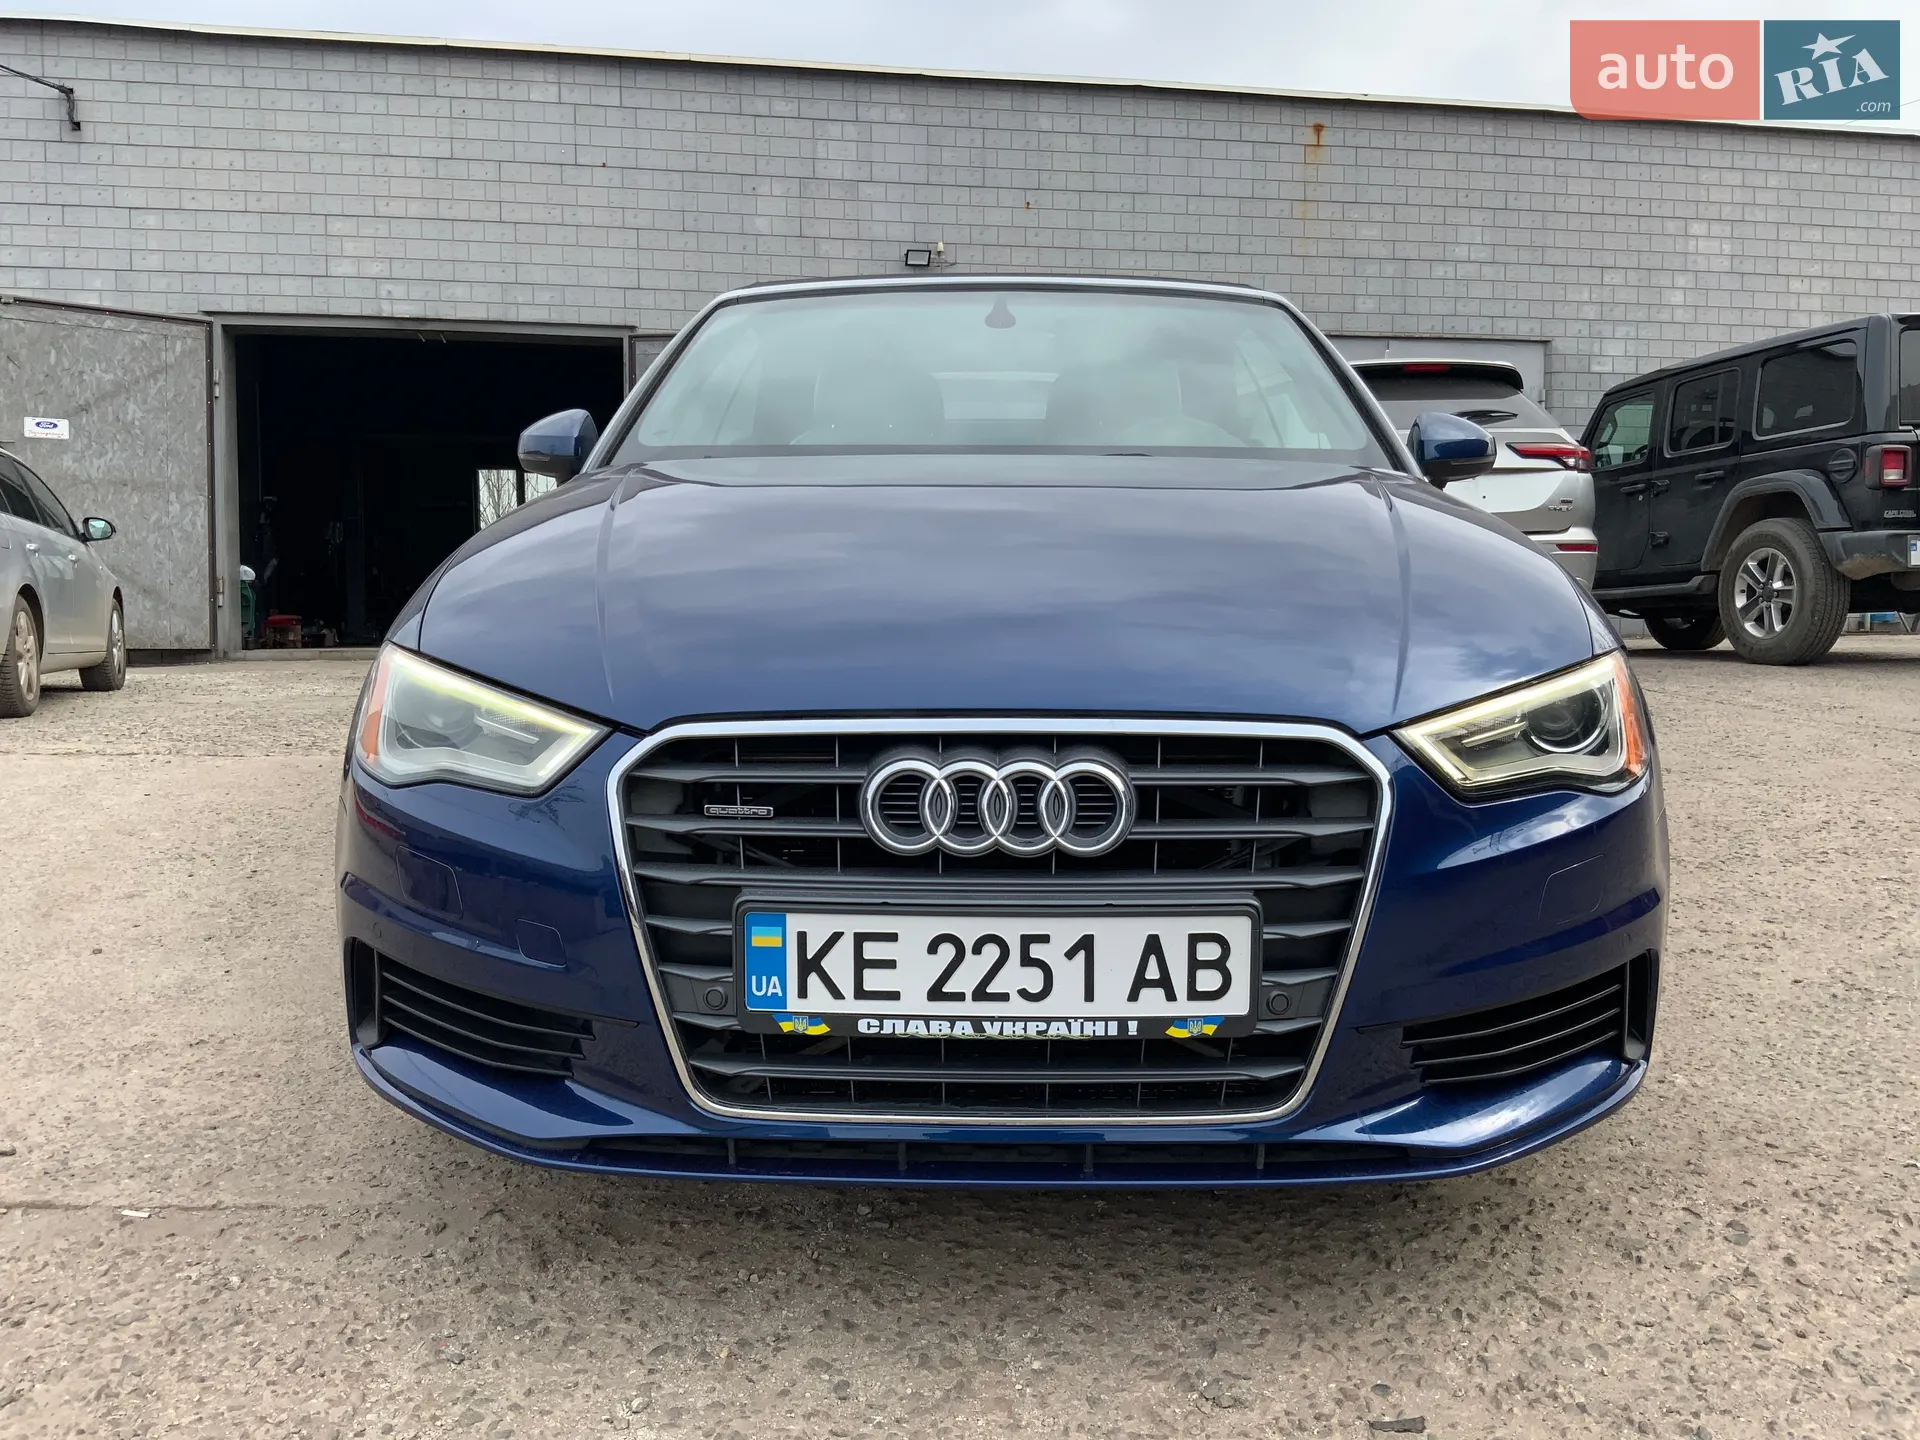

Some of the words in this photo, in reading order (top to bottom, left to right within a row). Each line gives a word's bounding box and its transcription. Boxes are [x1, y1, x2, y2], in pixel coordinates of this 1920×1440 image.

[709, 807, 768, 815] quattro
[796, 930, 901, 1001] KE
[926, 932, 1095, 1003] 2251
[1126, 932, 1233, 1003] AB
[751, 975, 783, 997] UA
[857, 1017, 975, 1036] СЛАВА
[981, 1018, 1118, 1037] УКРАЇНІ
